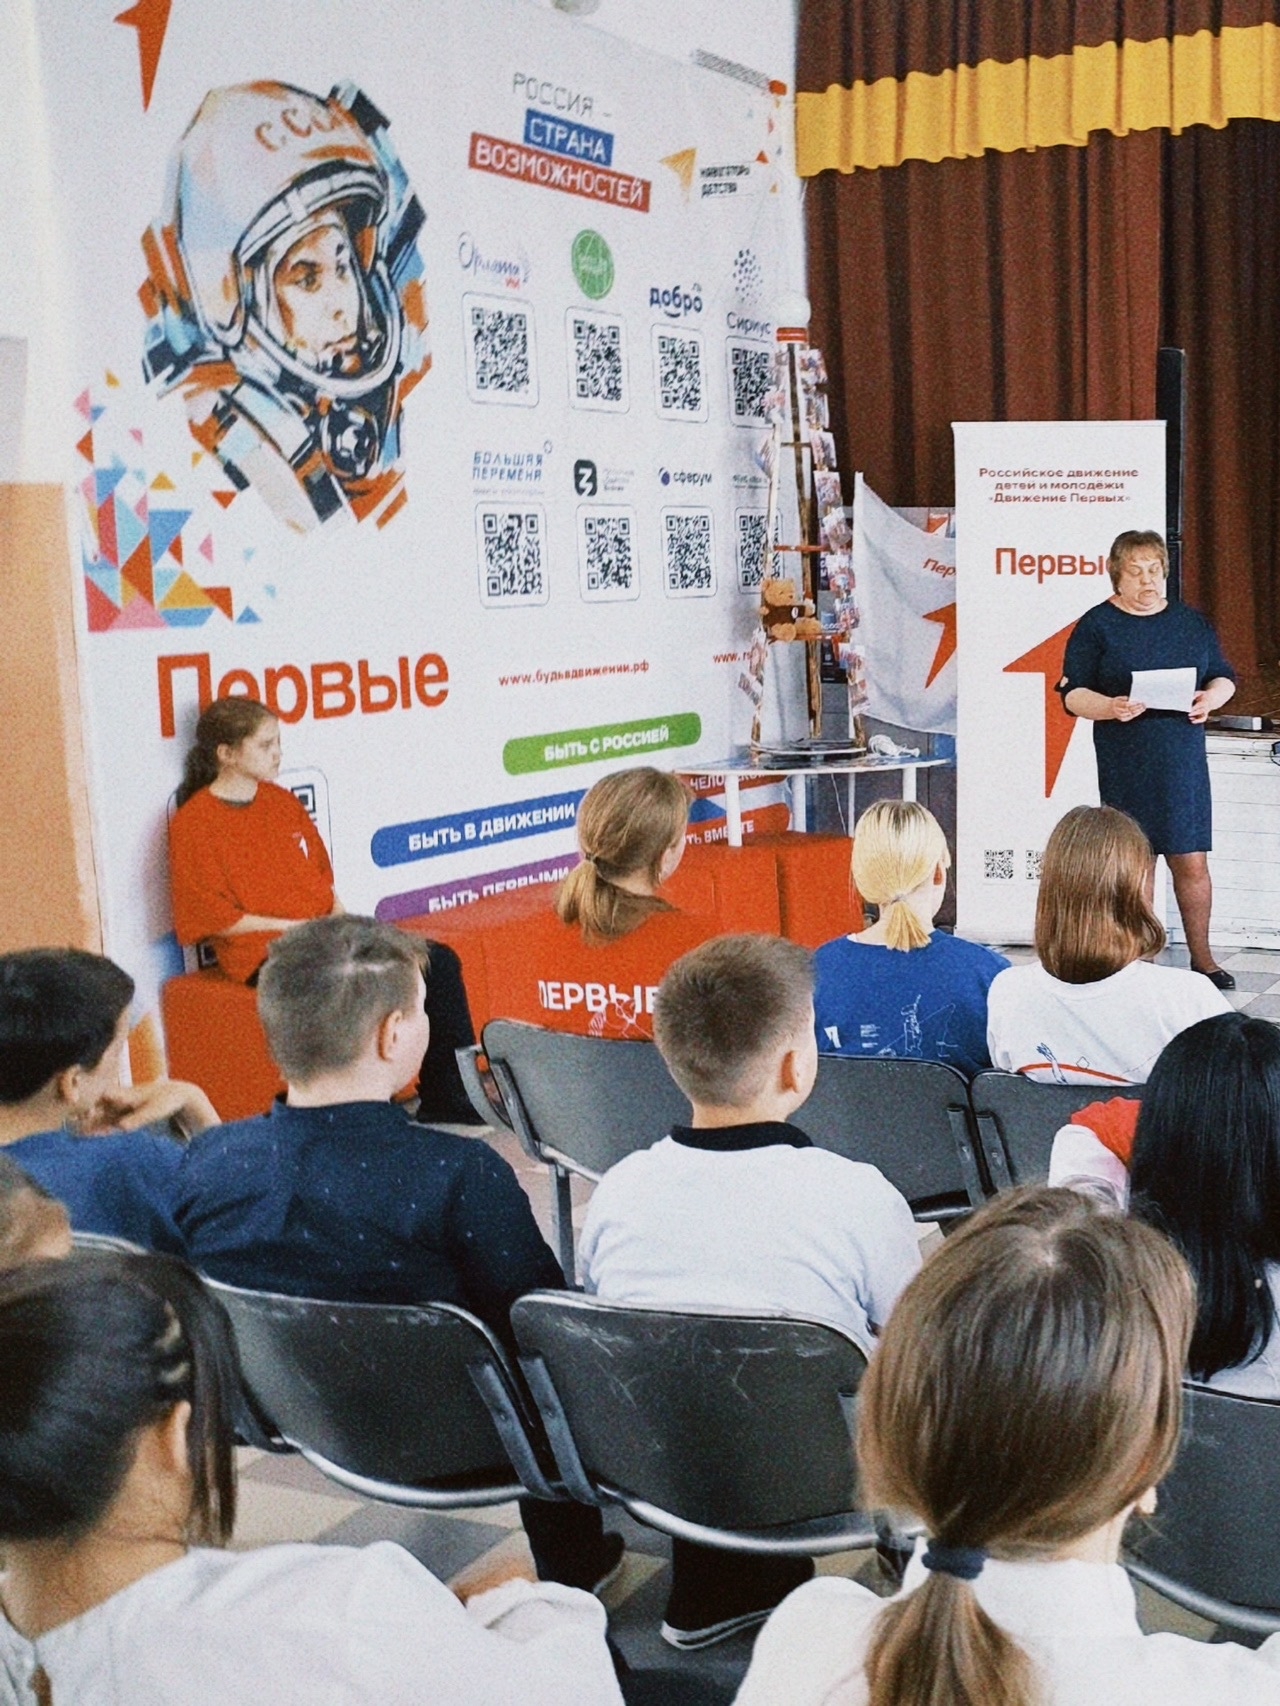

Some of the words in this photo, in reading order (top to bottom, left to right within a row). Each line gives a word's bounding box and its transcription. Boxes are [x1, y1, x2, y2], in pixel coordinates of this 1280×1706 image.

[512, 72, 594, 118] РОССИЯ
[529, 118, 607, 162] СТРАНА
[475, 138, 644, 207] ВОЗМОЖНОСТЕЙ
[726, 311, 771, 337] Сириус
[474, 451, 543, 466] БОЛЬШАЯ
[473, 466, 542, 481] ПЕРЕМЕНА
[979, 467, 1064, 478] Российское
[1066, 468, 1139, 478] движение
[995, 480, 1036, 490] детей
[923, 558, 956, 578] Пер
[996, 547, 1111, 584] Первы
[499, 660, 650, 686] www.будьвдвижении.рф
[544, 743, 588, 762] БЫТЬ
[590, 738, 600, 755] С
[602, 725, 670, 752] РОССИЕЙ
[408, 828, 462, 852] БЫТЬ
[464, 823, 475, 840] В
[479, 803, 575, 839] ДВИЖЕНИИ
[704, 819, 755, 844] ВМЕТЕ
[428, 888, 480, 914] БЫТЬ
